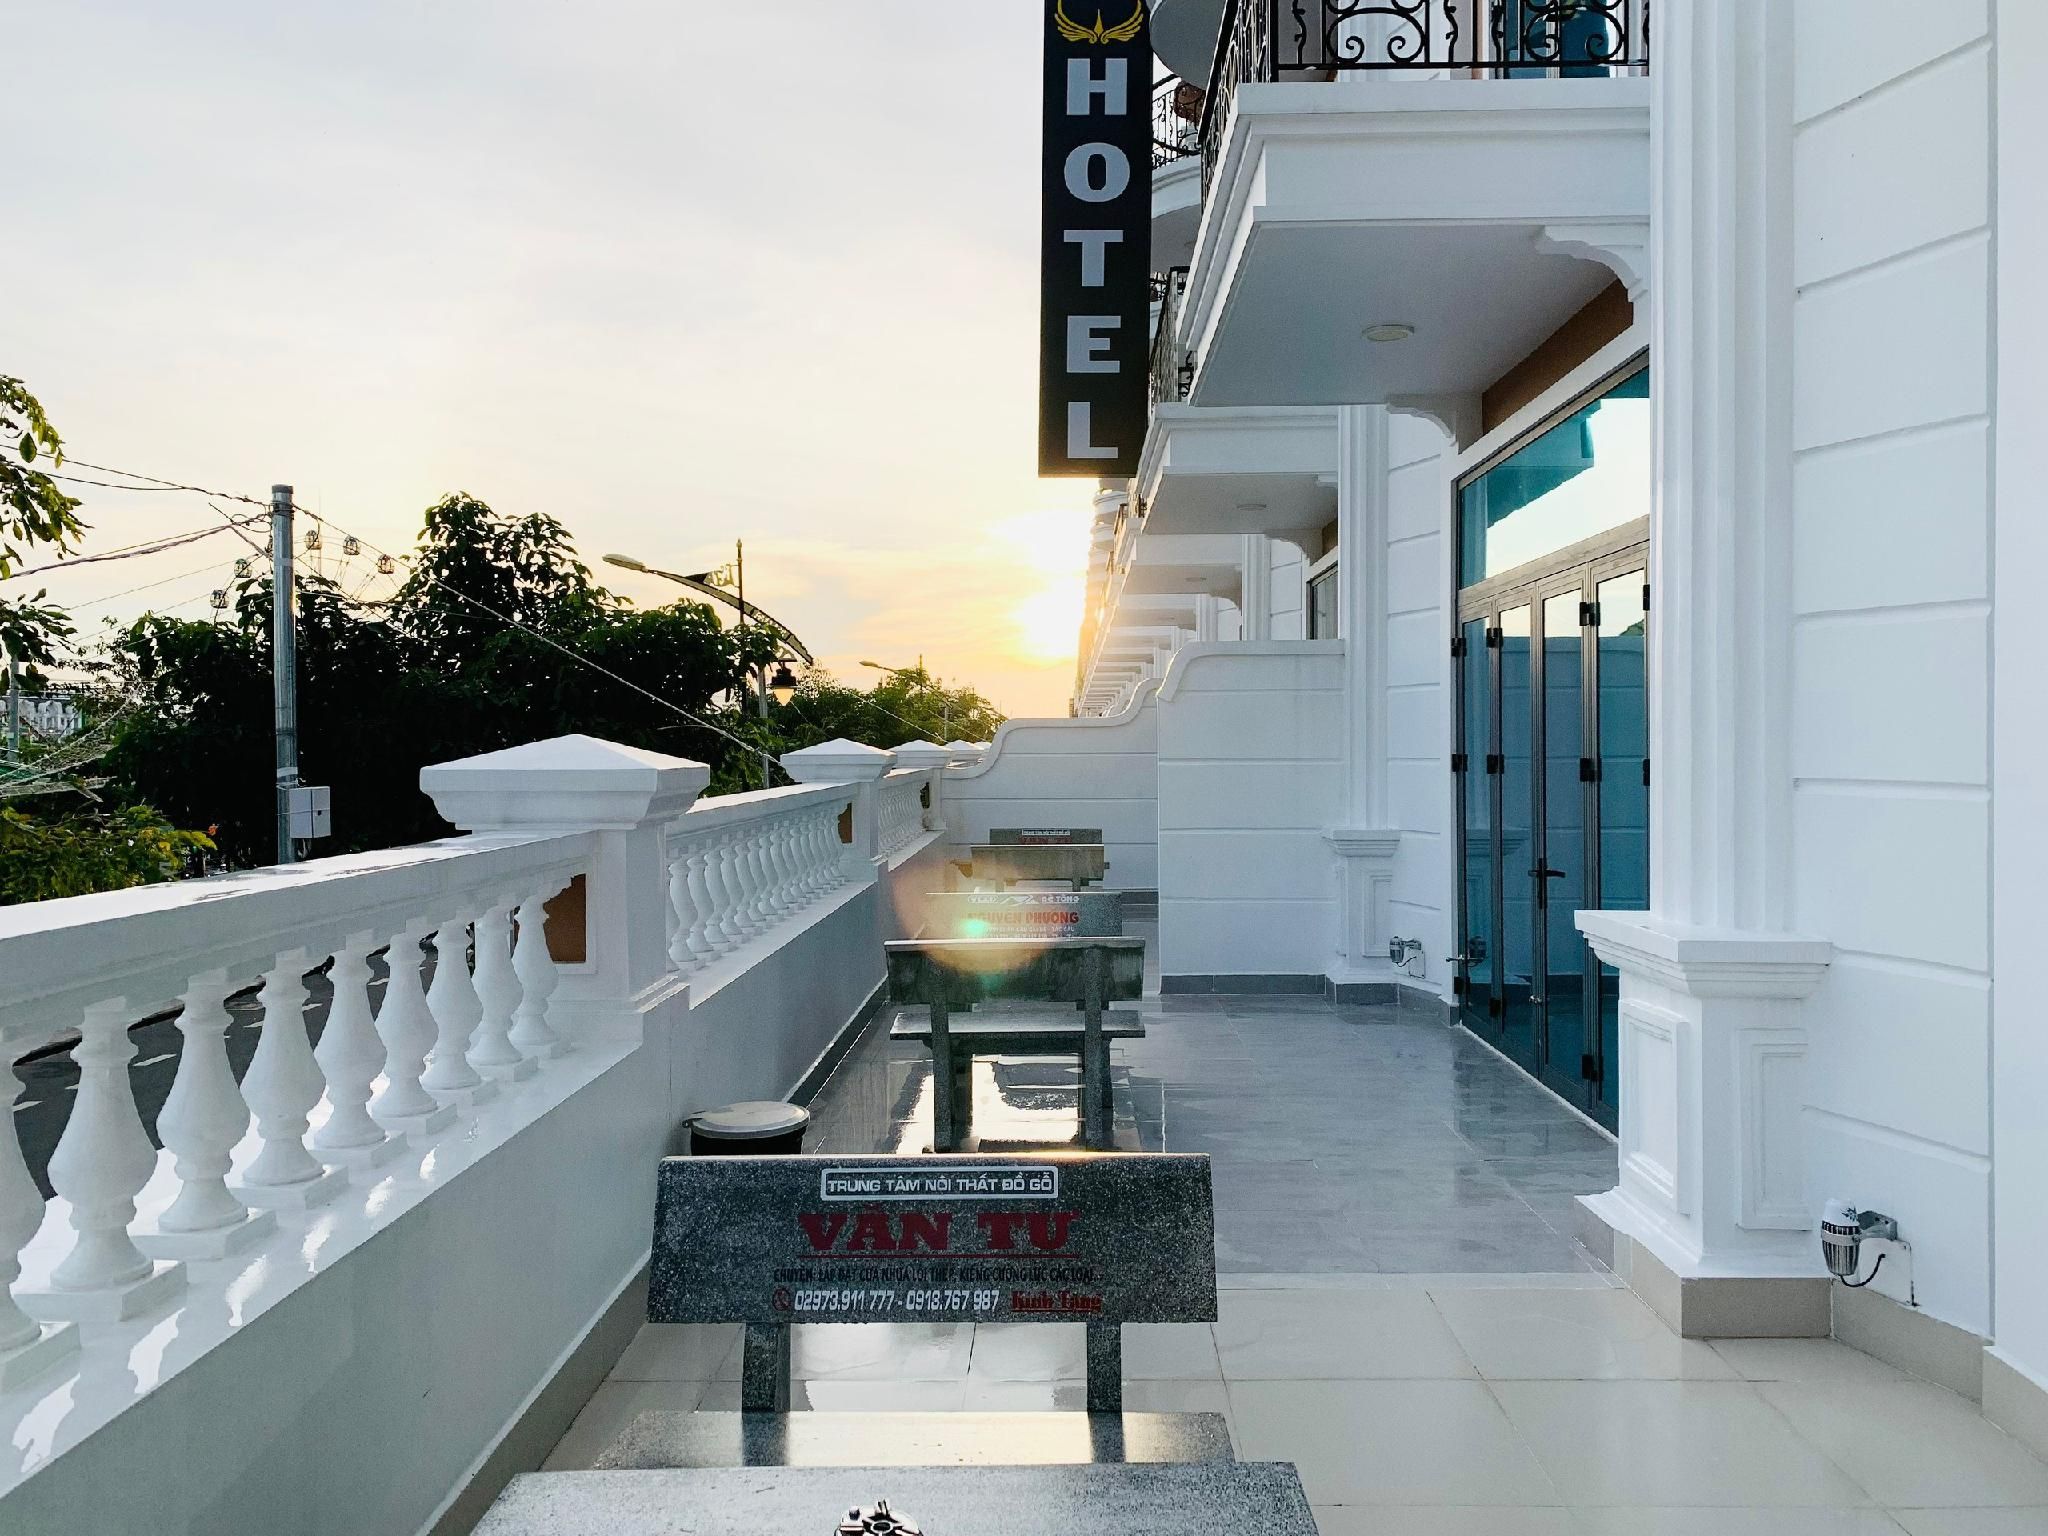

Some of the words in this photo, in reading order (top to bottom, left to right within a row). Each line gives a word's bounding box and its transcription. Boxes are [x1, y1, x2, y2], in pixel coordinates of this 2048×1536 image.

[1064, 58, 1130, 458] HOTEL
[827, 1178, 881, 1192] TRUNG
[888, 1175, 920, 1192] TÂM
[956, 1172, 998, 1192] THẤT
[1001, 1171, 1024, 1191] ĐỒ
[1029, 1171, 1052, 1191] GỖ
[978, 1209, 1080, 1250] TƯ
